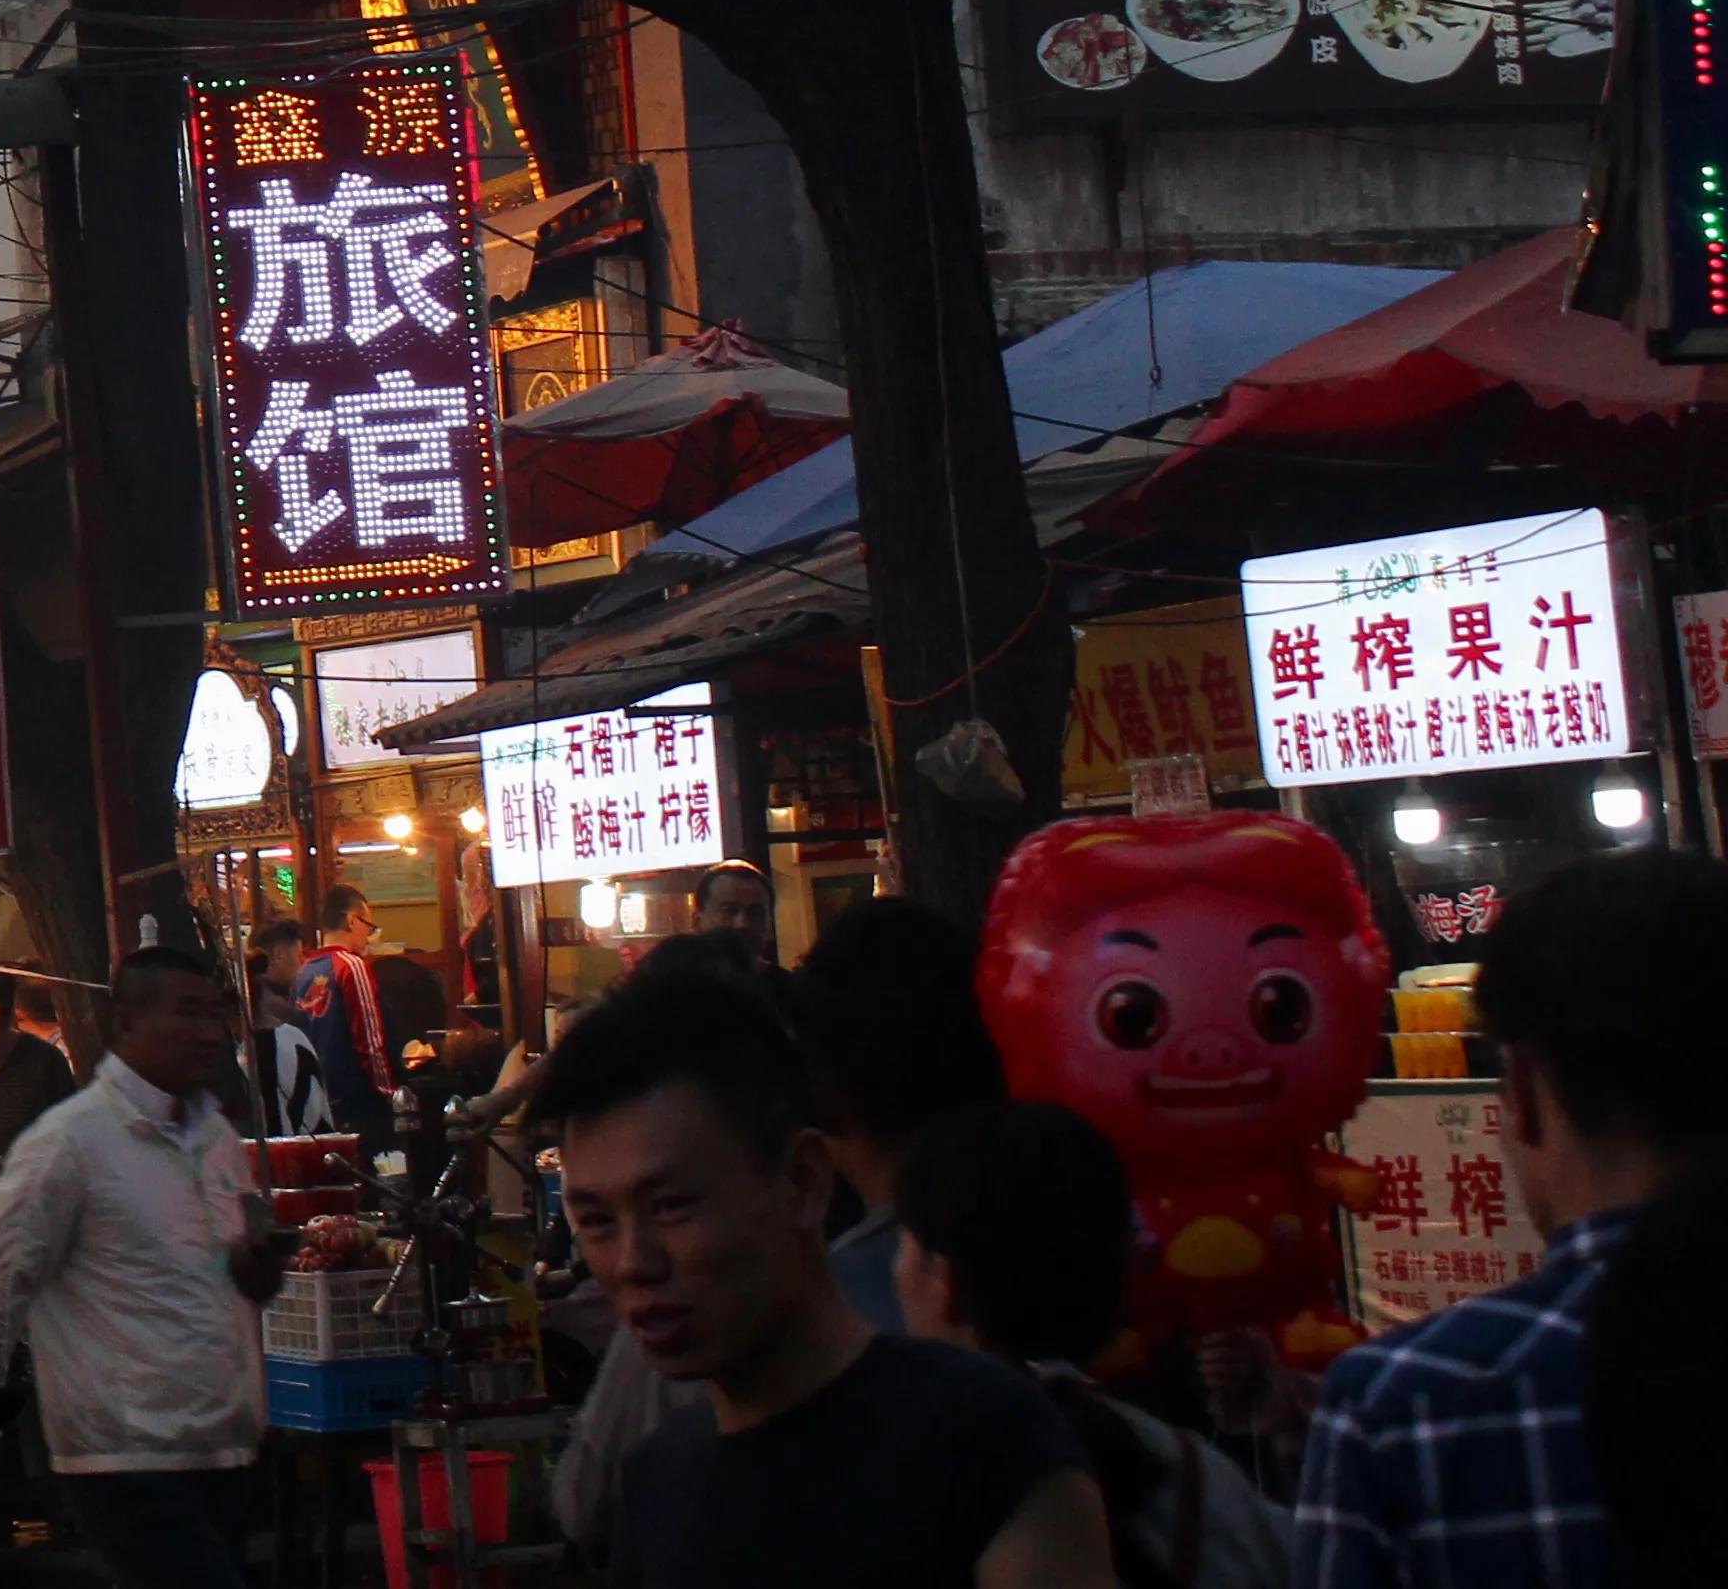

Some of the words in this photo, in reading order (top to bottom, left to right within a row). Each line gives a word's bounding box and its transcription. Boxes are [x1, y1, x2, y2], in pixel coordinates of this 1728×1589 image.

[231, 83, 448, 166] 鑫源
[227, 171, 470, 554] 旅馆
[1268, 591, 1592, 701] 鲜榨果汁
[564, 715, 639, 780] 石榴汁
[1541, 679, 1612, 749] 老酸奶
[501, 779, 560, 853] 鲜榨
[569, 791, 647, 860] 酸梅汁
[657, 779, 712, 847] 柠檬
[1360, 1154, 1507, 1237] 鲜榨
